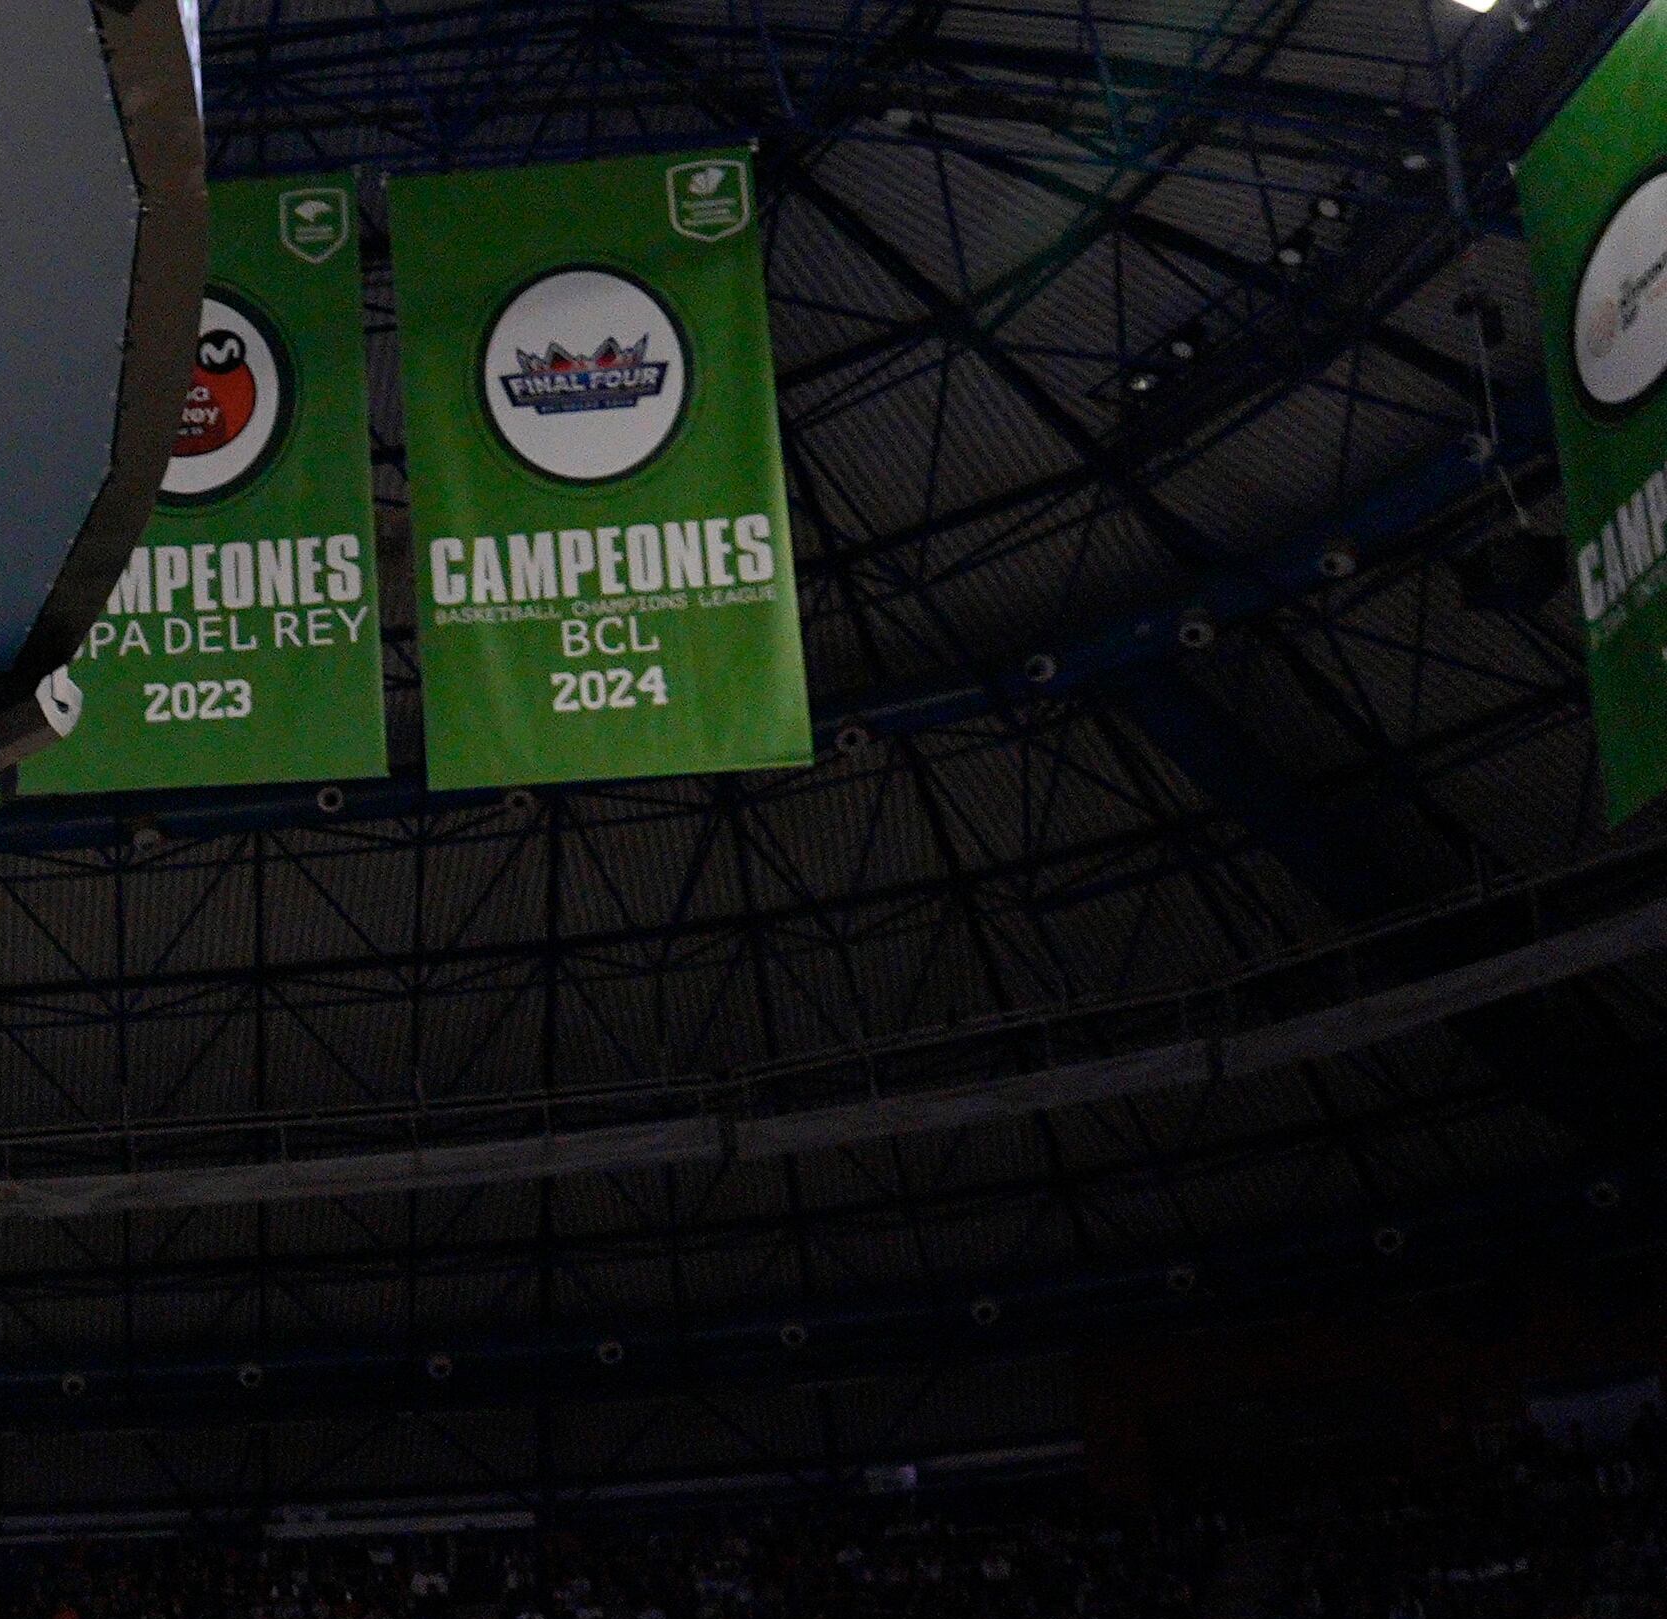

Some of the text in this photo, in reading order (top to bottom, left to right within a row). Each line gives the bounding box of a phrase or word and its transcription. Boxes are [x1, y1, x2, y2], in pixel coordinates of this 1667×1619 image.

[107, 534, 362, 614] MPEONES
[429, 513, 776, 605] CAMPEONES
[73, 605, 368, 660] PA DEL REY
[560, 615, 661, 657] BCL
[144, 678, 252, 723] 2023
[551, 665, 669, 713] 2024
